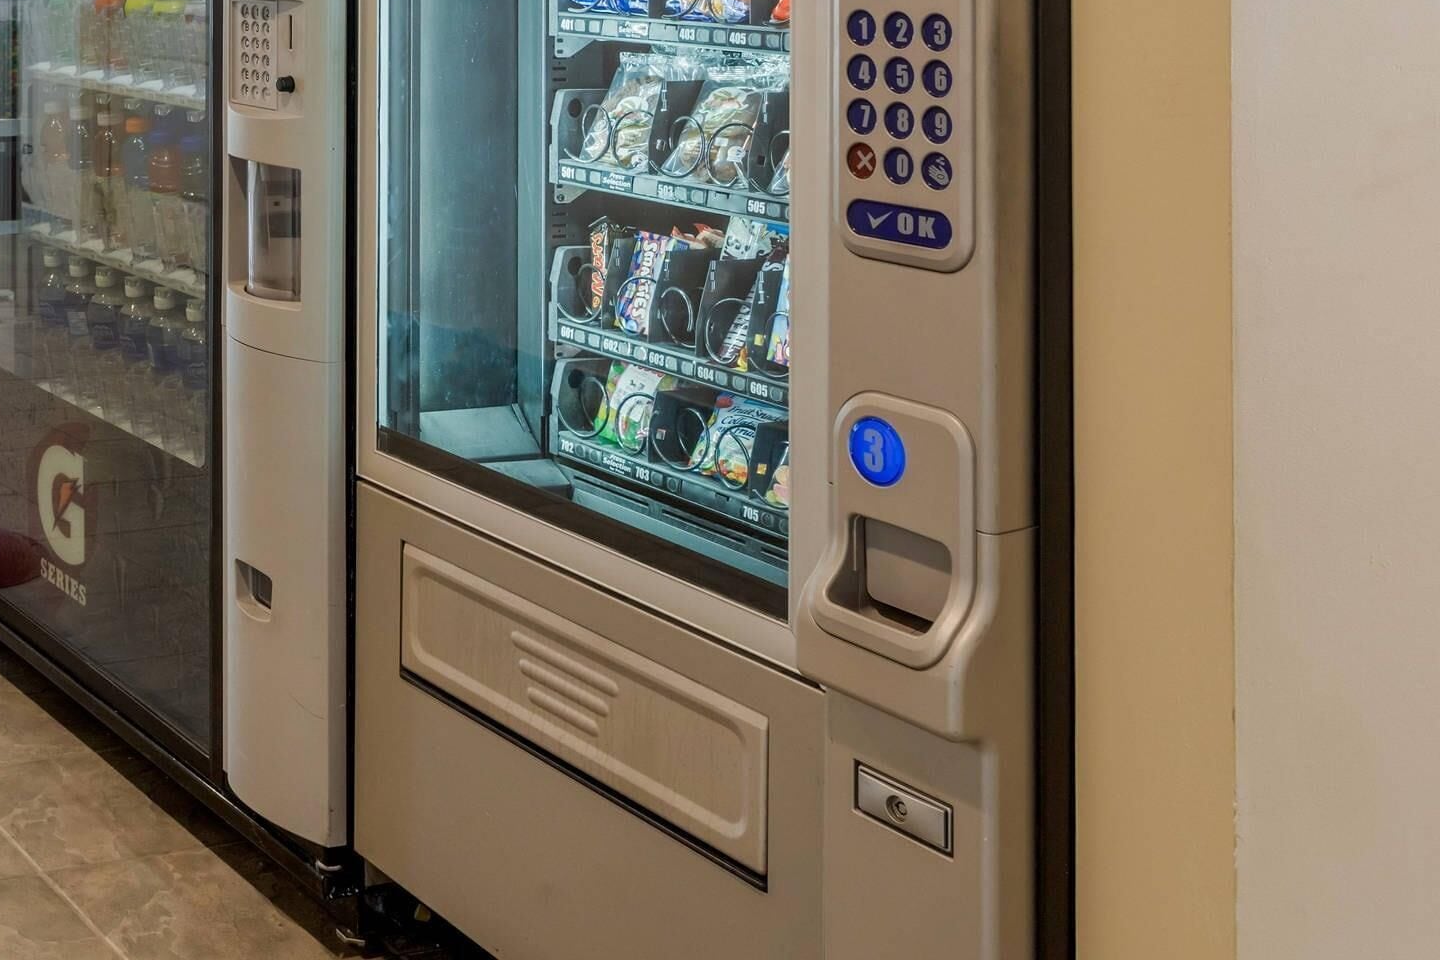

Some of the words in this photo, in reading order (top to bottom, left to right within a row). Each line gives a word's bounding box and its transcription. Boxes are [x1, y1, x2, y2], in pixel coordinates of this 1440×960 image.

[561, 19, 574, 31] 401
[679, 28, 695, 41] 403
[729, 31, 747, 45] 405
[858, 16, 868, 40] 1
[895, 18, 908, 43] 2
[933, 20, 946, 46] 3
[858, 60, 871, 84] 4
[896, 63, 909, 88] 5
[934, 66, 947, 92] 6
[860, 104, 871, 128] 7
[896, 108, 909, 133] 8
[934, 112, 947, 137] 9
[561, 166, 575, 179] 501
[896, 153, 908, 178] 0
[602, 176, 631, 188] Selection
[657, 184, 674, 198] 503
[747, 199, 766, 214] 505
[897, 212, 936, 239] OK
[561, 327, 574, 340] 601
[603, 339, 619, 353] 602
[649, 352, 665, 366] 603
[697, 366, 714, 382] 604
[750, 381, 768, 396] 605
[561, 440, 575, 453] 702
[863, 428, 885, 473] 3
[602, 456, 632, 473] Selection
[37, 445, 86, 566] G
[635, 467, 650, 481] 703
[743, 506, 759, 521] 705
[40, 557, 87, 607] SERIES
